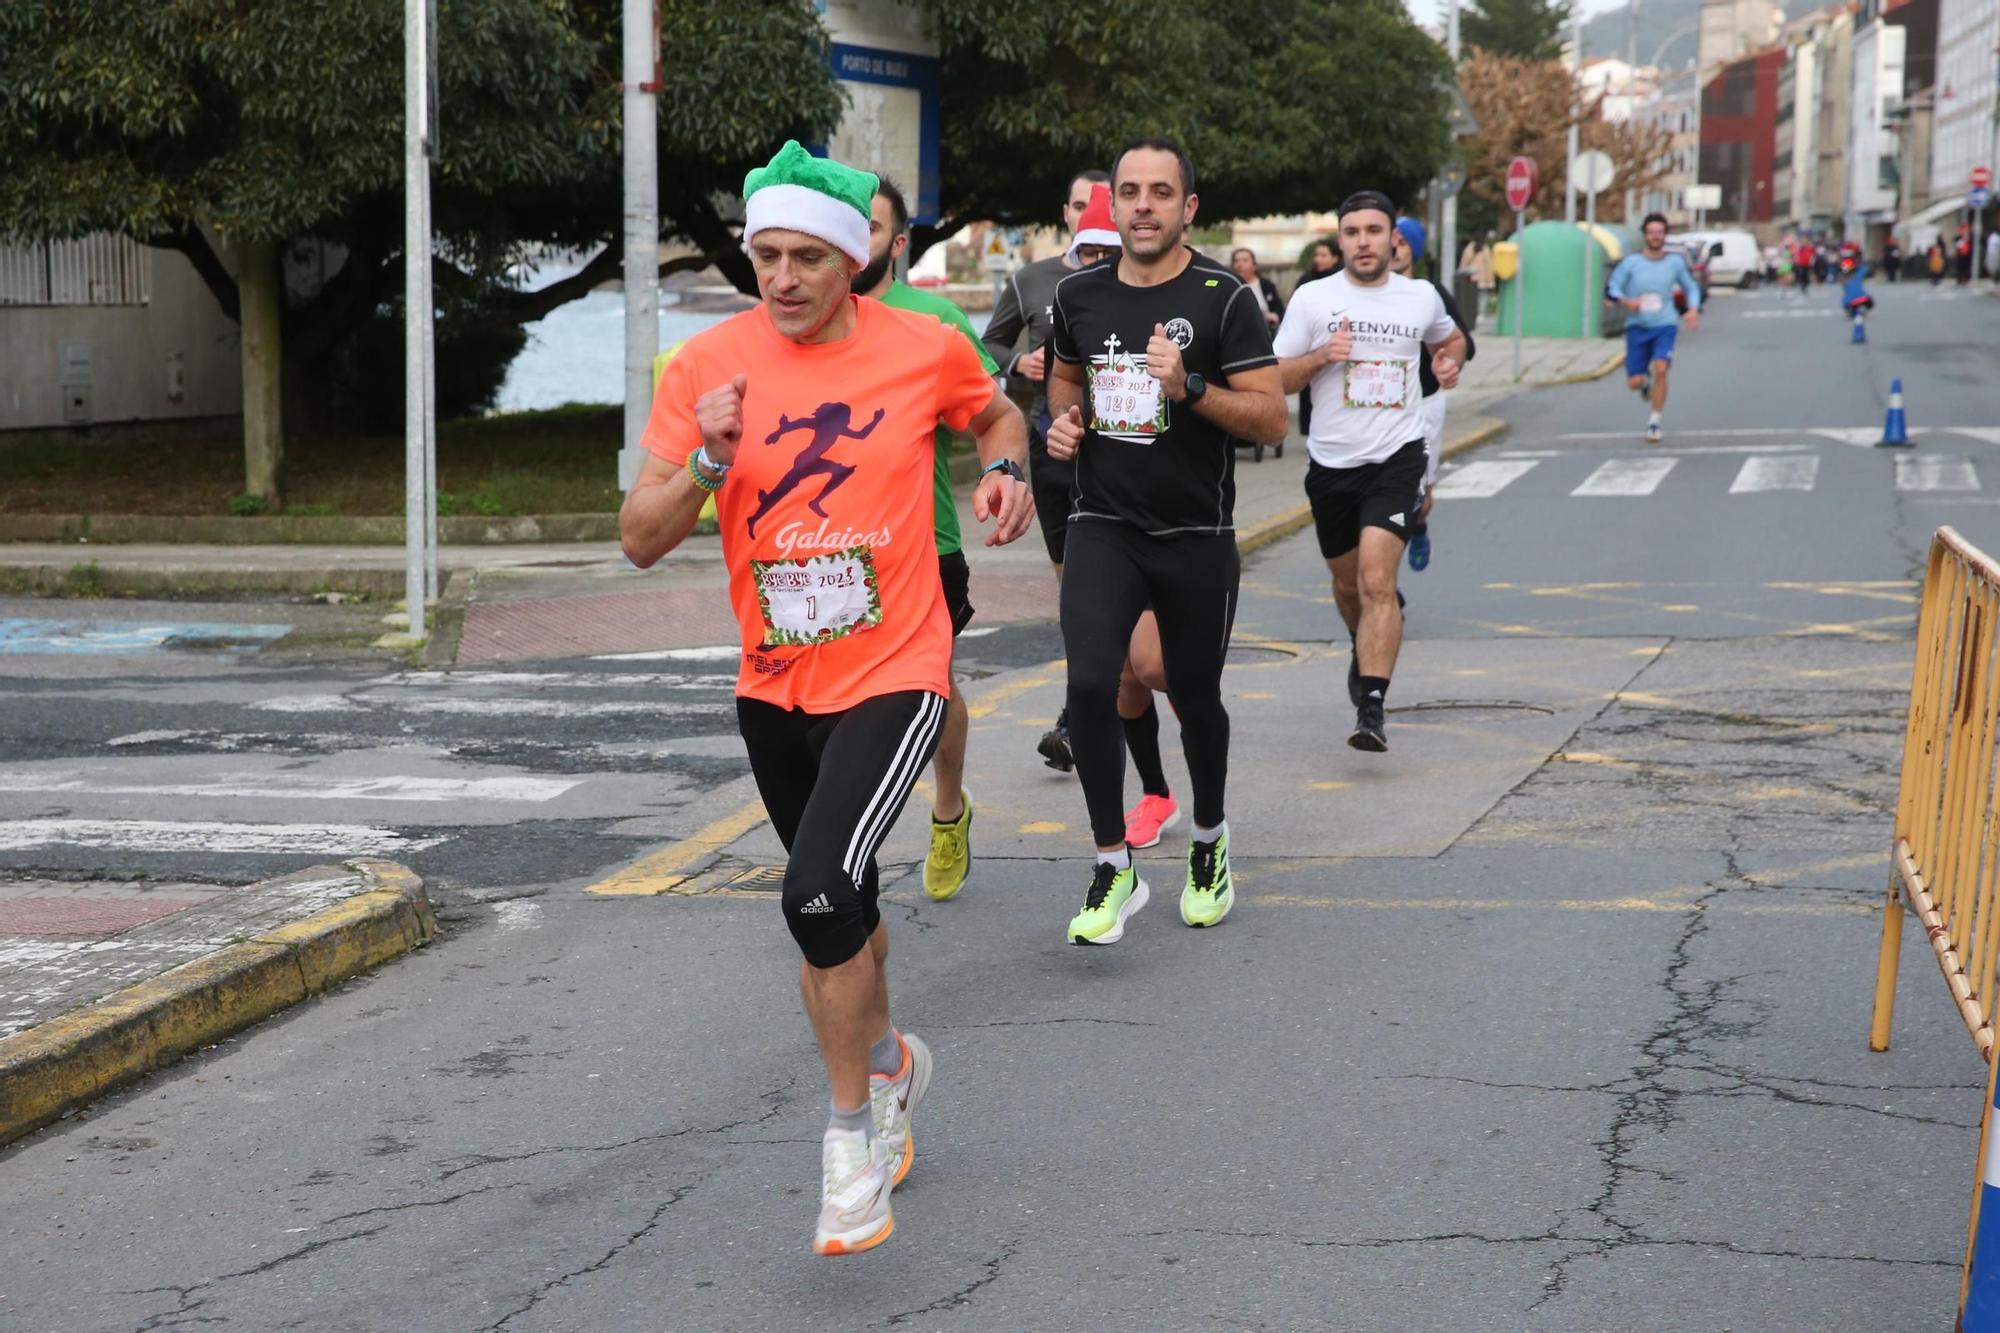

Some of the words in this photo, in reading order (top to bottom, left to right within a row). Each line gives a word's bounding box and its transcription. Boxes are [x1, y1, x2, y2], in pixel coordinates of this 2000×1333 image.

[842, 54, 872, 73] PORTO
[1508, 176, 1530, 190] STOP
[1352, 335, 1394, 344] SOCCER
[1128, 381, 1153, 391] 2023
[1105, 395, 1135, 412] 129
[775, 519, 892, 559] Galaicas
[818, 570, 854, 588] 2023
[806, 595, 816, 620] 1
[801, 905, 833, 914] adidas
